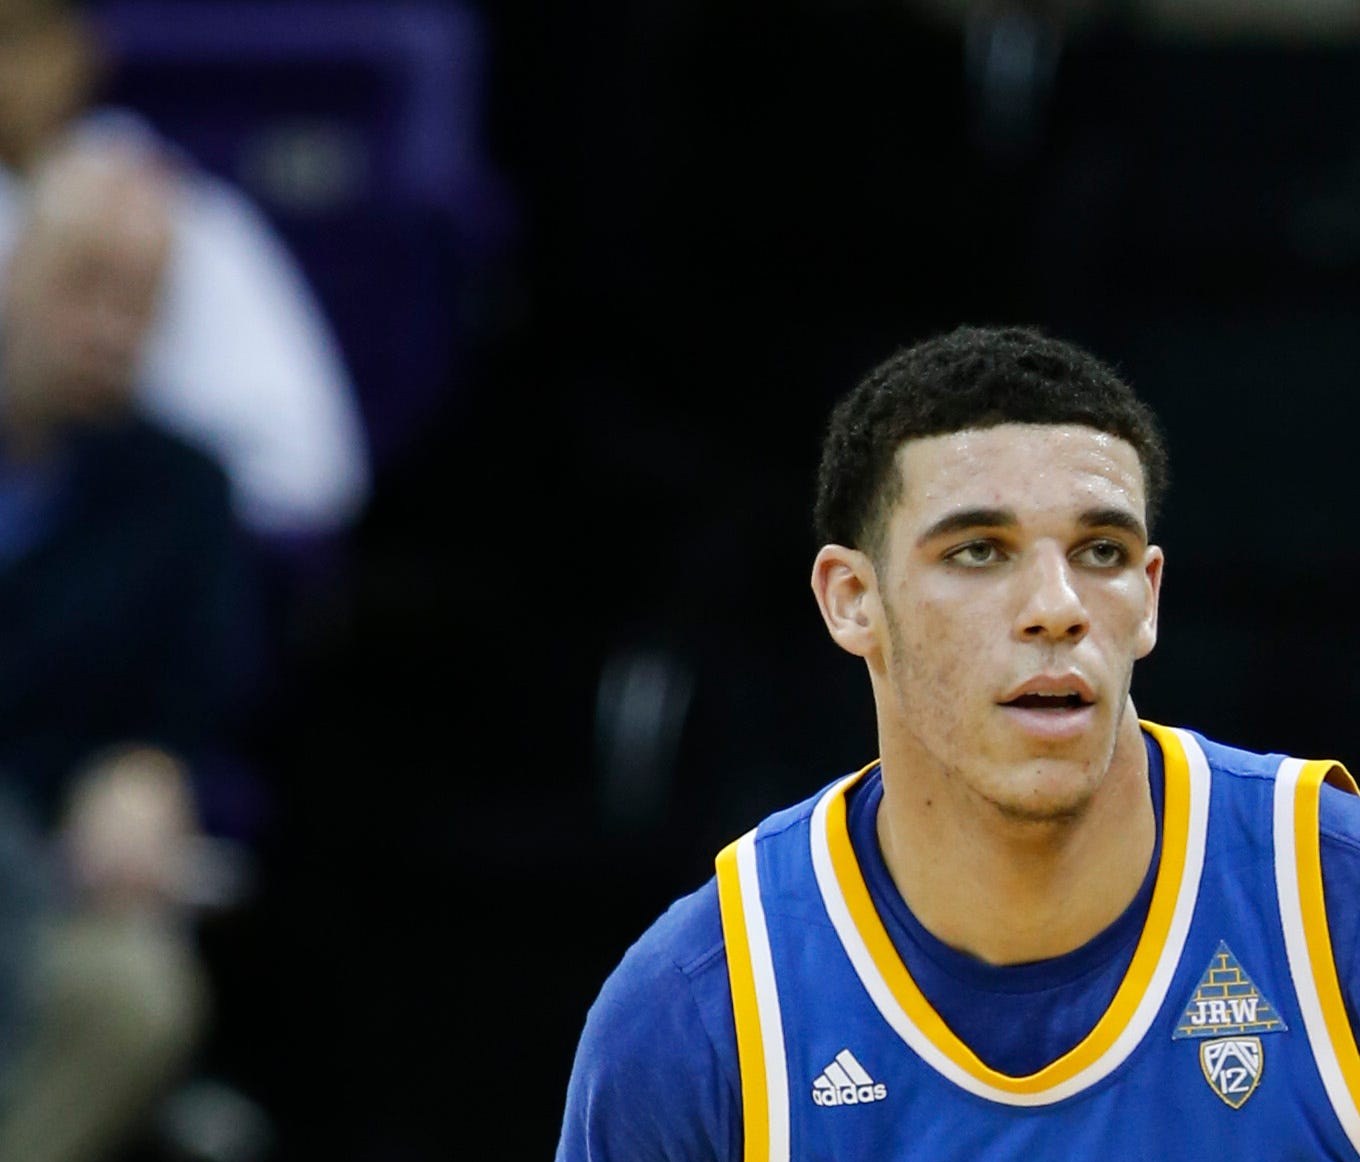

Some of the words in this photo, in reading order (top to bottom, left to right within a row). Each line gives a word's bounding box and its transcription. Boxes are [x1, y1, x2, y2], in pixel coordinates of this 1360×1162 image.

[1191, 998, 1259, 1026] JRW
[1203, 1041, 1260, 1082] PAC
[1220, 1066, 1250, 1095] 12
[812, 1084, 888, 1108] adidas
